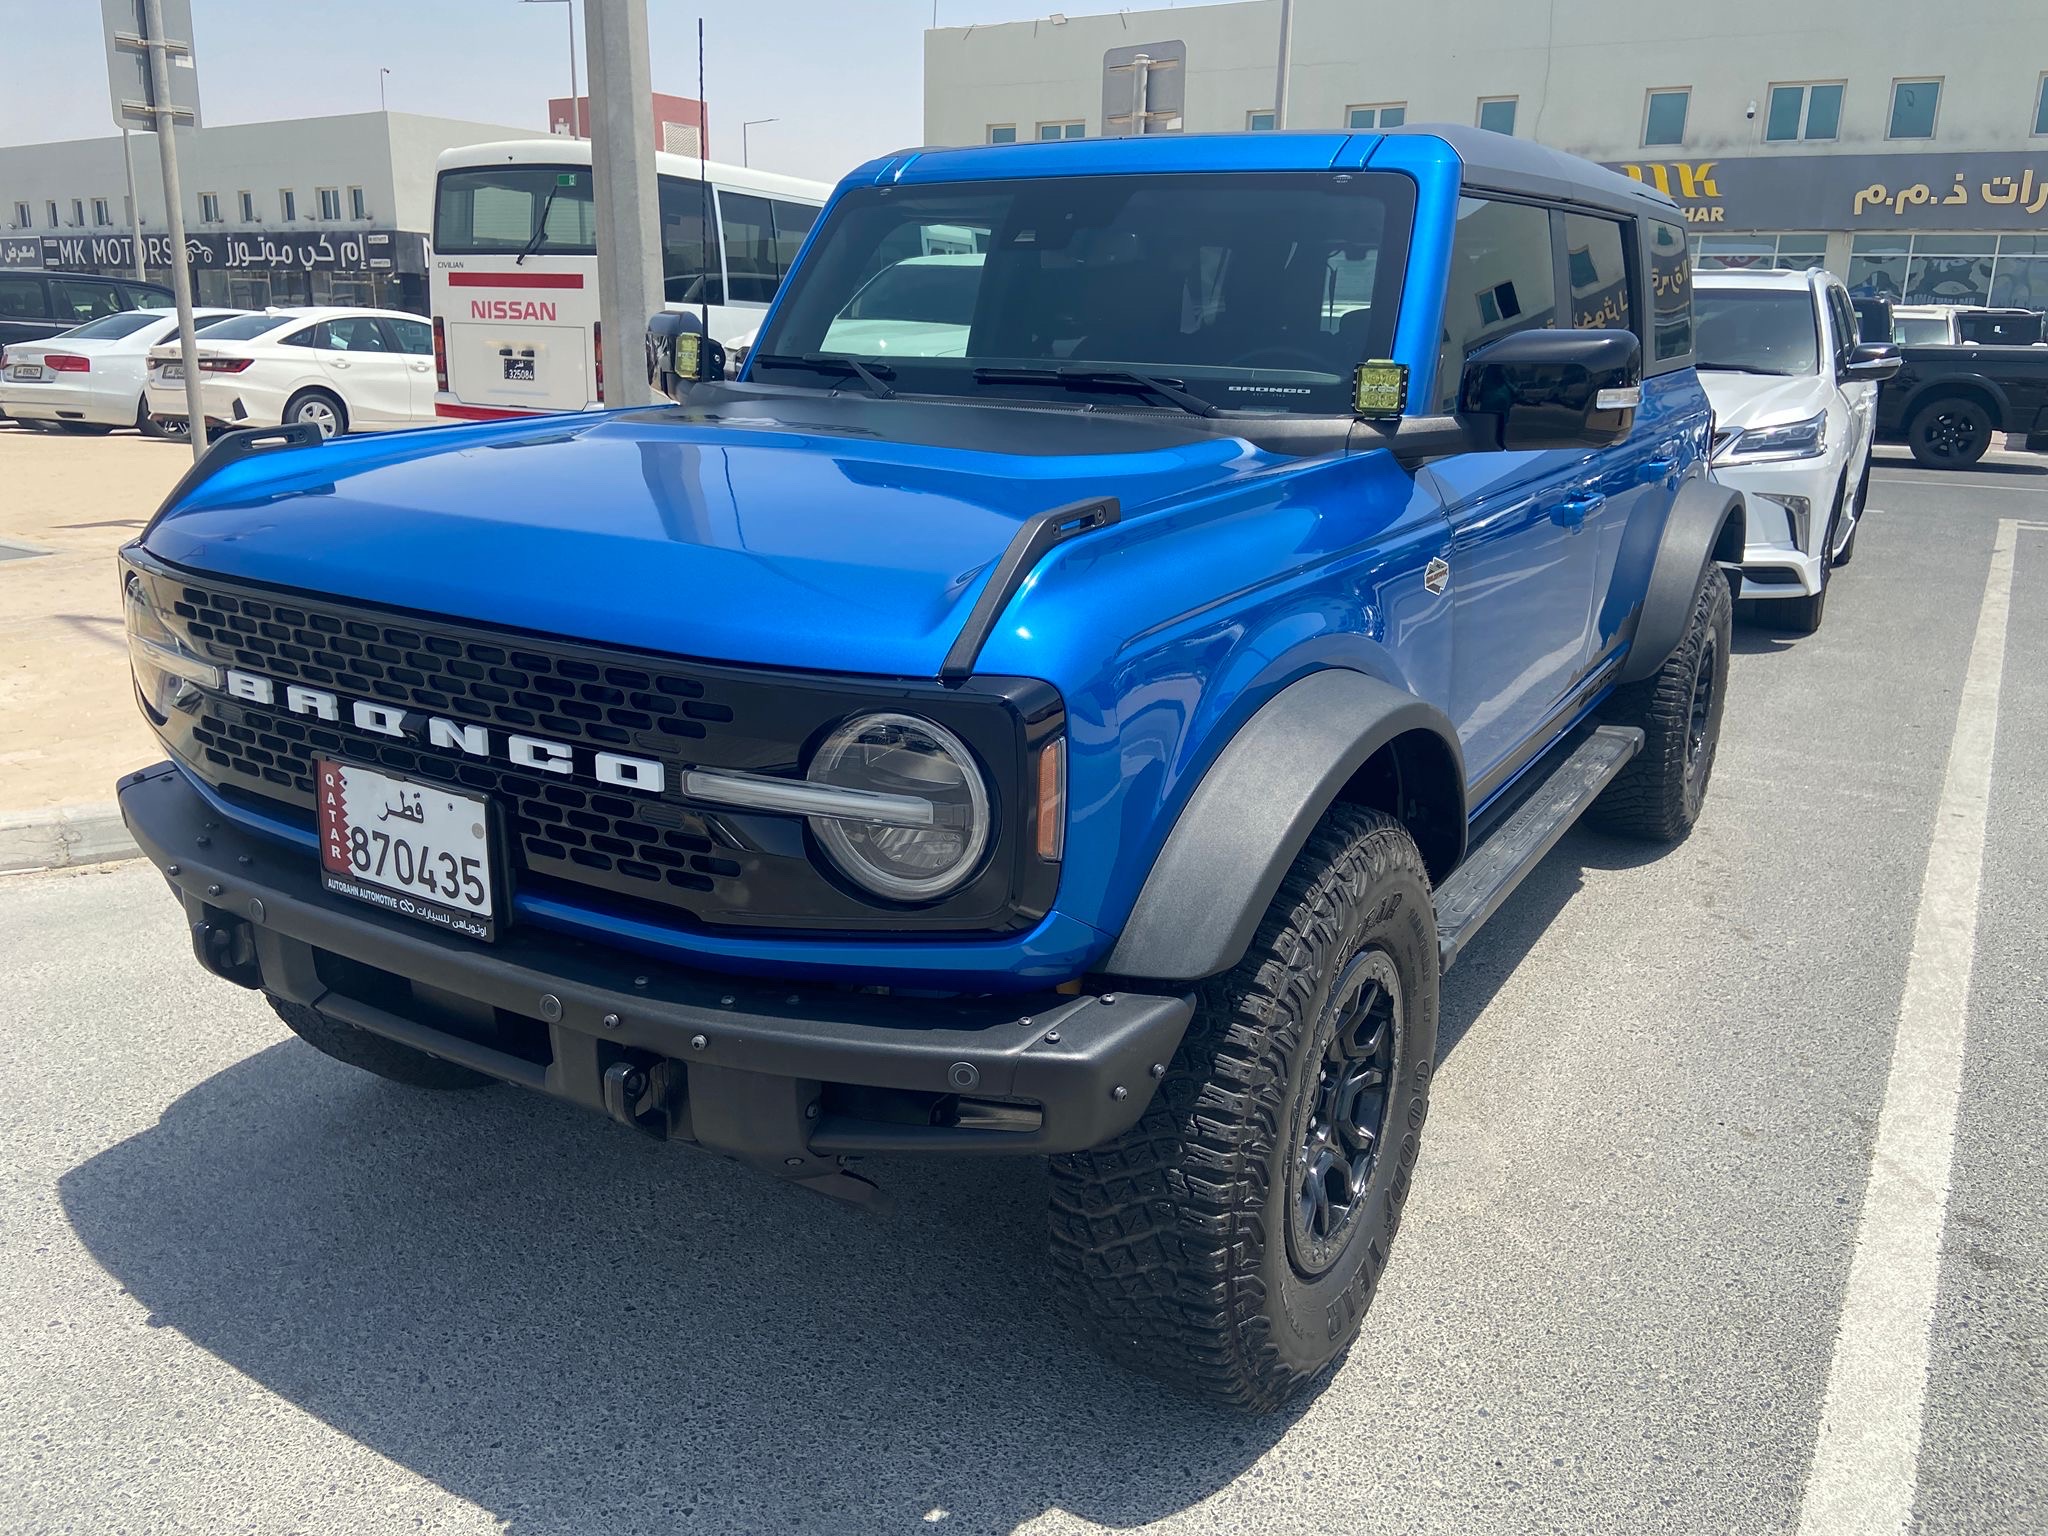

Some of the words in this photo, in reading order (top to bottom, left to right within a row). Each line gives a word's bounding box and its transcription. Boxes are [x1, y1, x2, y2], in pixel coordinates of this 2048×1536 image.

[5, 242, 35, 263] معرض
[59, 239, 87, 265] MK
[225, 236, 293, 267] موتورز
[299, 234, 334, 270] كي
[341, 233, 367, 269] إم
[437, 261, 464, 269] CIVILIAN
[471, 300, 556, 321] NISSAN
[1228, 385, 1311, 394] BRONCO
[227, 669, 665, 793] BRONCO
[325, 773, 341, 860] QATAR
[377, 789, 424, 824] قطر
[351, 826, 485, 906] 870435
[328, 878, 359, 896] AUTOBAHN
[359, 888, 397, 909] AUTOMOTIVE
